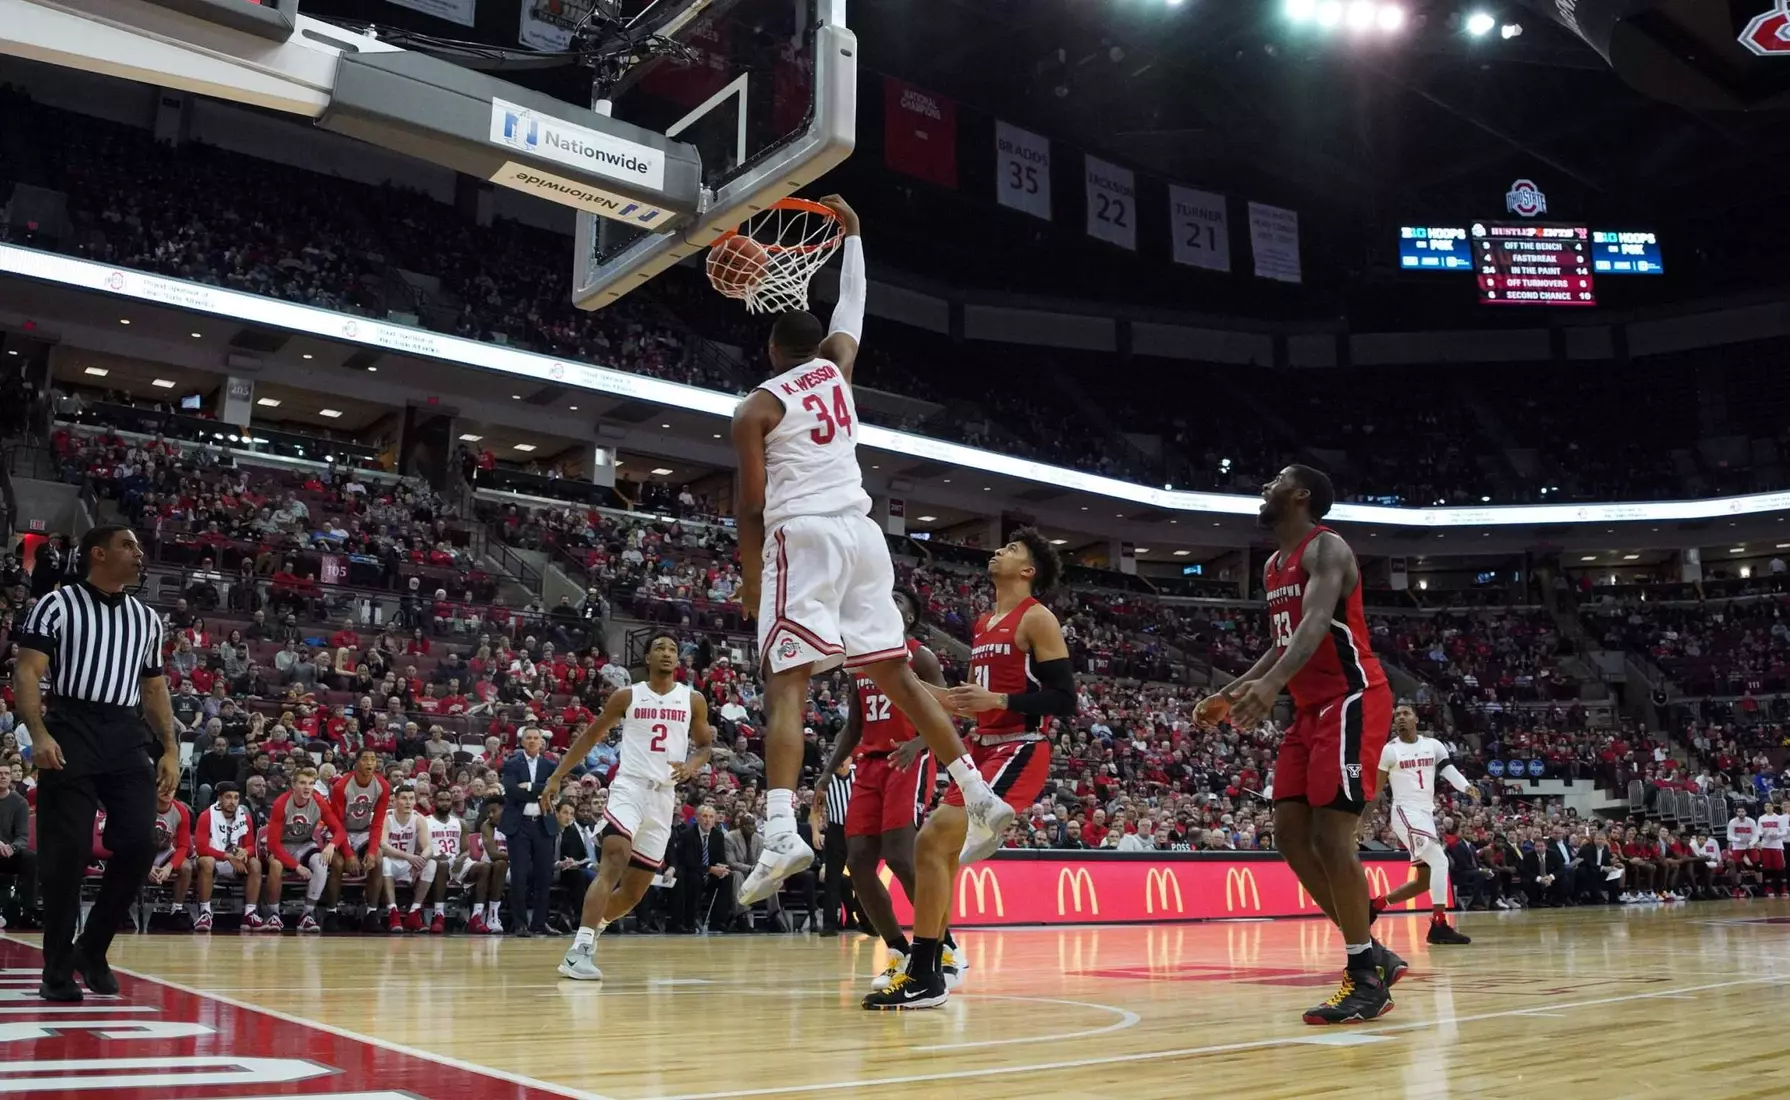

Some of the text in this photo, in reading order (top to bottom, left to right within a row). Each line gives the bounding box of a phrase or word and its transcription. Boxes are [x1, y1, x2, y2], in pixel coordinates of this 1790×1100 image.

[545, 131, 648, 174] Nationwide
[1010, 161, 1038, 195] 35
[1088, 172, 1134, 198] JACKSON
[516, 172, 619, 210] Nationwide
[1097, 193, 1127, 228] 22
[1176, 203, 1222, 221] TURNER
[1186, 222, 1216, 252] 21
[1427, 227, 1466, 240] HOOPS
[1618, 232, 1656, 244] HOOPS
[1504, 241, 1519, 250] OFF
[1519, 242, 1535, 251] THE
[1535, 242, 1562, 251] BENCH
[1574, 243, 1583, 252] 4
[1483, 253, 1492, 262] 4
[1512, 254, 1557, 263] FASTBREAK
[1482, 265, 1589, 276] 24 IN THE PAINT 14
[1506, 279, 1521, 288] OFF
[1522, 279, 1569, 288] TURNOVERS
[1506, 290, 1539, 300] SECOND
[1539, 291, 1572, 301] CHANCE
[781, 364, 838, 396] K. WESSON
[802, 384, 852, 446] 34
[634, 707, 686, 722] OHIO STATE
[866, 694, 891, 722] 32
[650, 723, 667, 752] 2
[1400, 760, 1416, 769] OHIO
[1416, 769, 1424, 790] 1
[438, 839, 456, 854] 32
[1171, 843, 1190, 851] POSS
